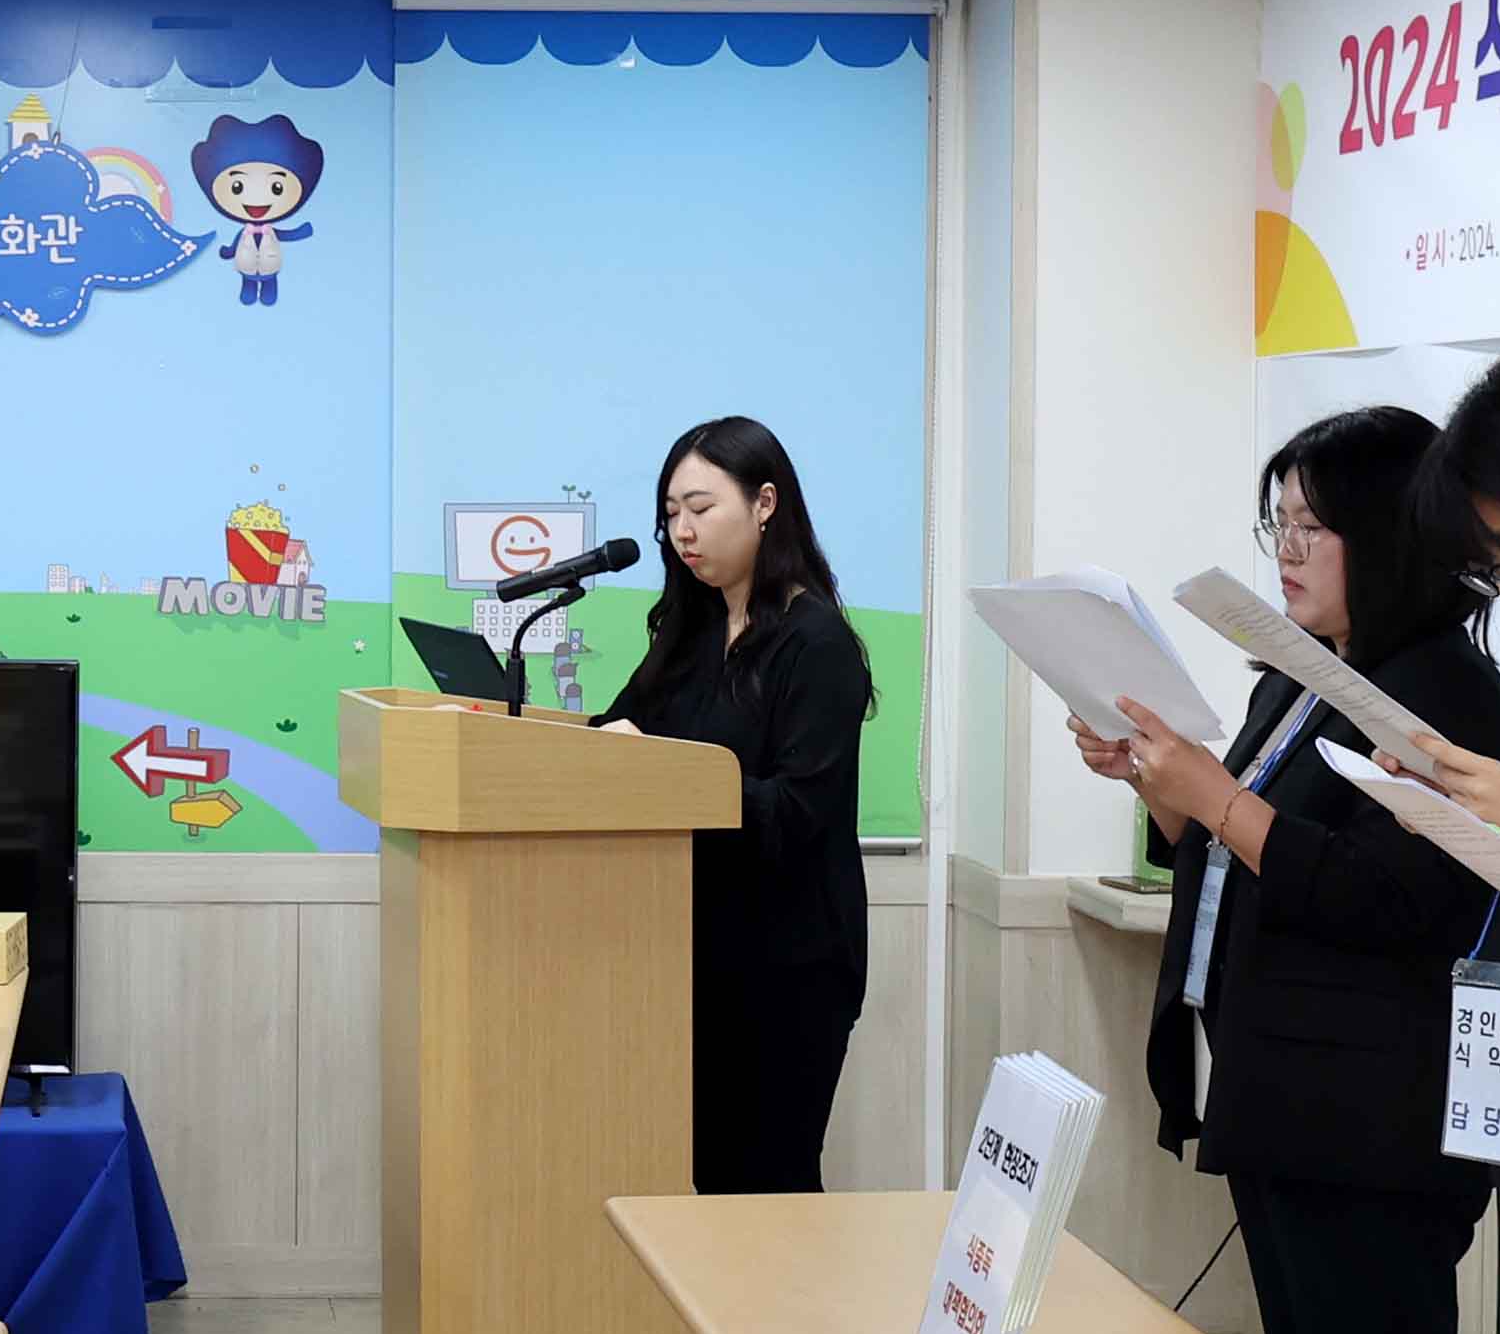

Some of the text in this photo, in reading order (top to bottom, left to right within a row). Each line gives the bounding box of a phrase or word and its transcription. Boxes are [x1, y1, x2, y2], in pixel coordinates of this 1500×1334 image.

[1339, 1, 1462, 155] 2024
[157, 576, 327, 624] MOVIE
[977, 1125, 1039, 1194] 2단계 현장조치
[965, 1232, 995, 1282] 식중독
